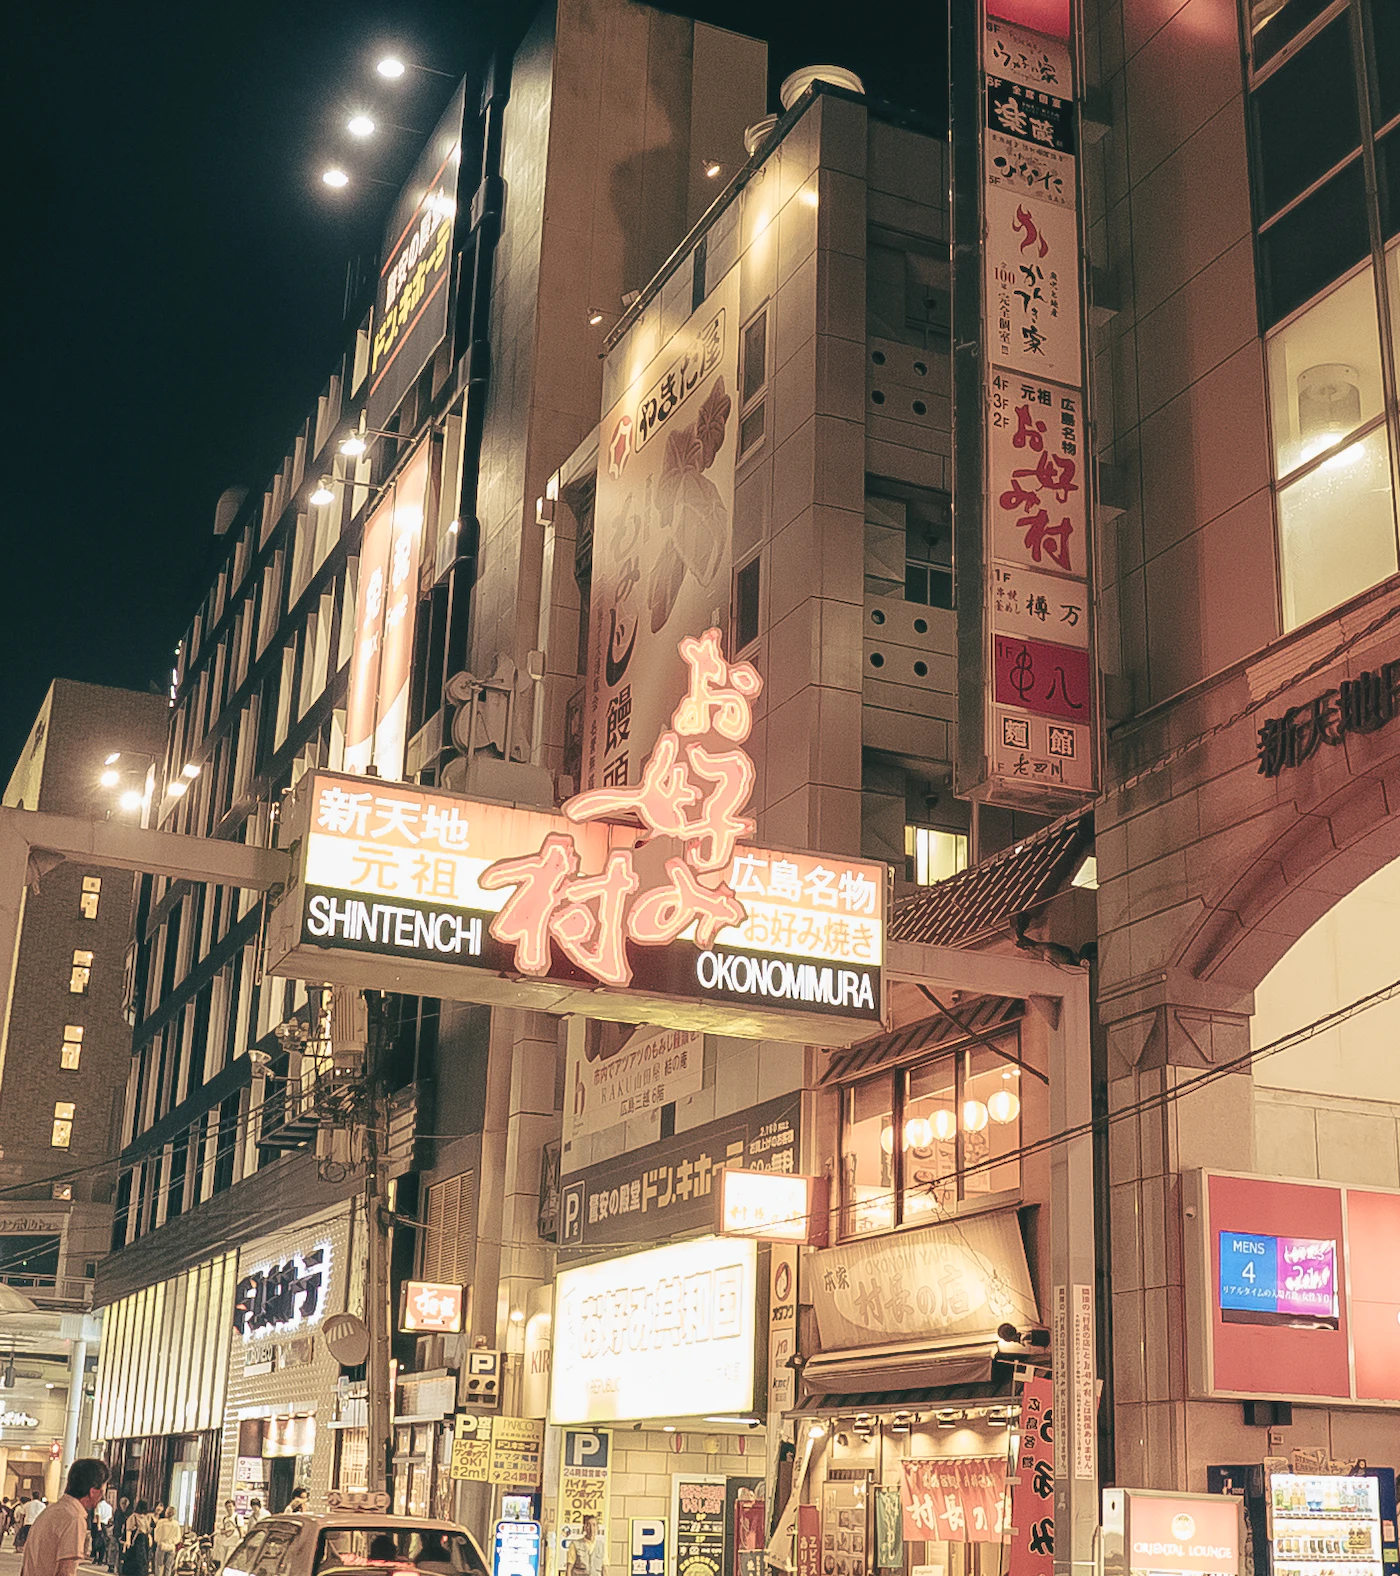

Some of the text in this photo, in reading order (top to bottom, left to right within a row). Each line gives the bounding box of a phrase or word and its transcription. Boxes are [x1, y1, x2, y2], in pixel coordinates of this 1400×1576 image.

[993, 156, 1063, 194] ひなた
[993, 375, 1009, 391] 4F
[1020, 383, 1052, 407] 元祖
[993, 393, 1009, 410] 3F
[993, 412, 1010, 429] 2F
[1061, 398, 1077, 456] 広島名物
[1000, 404, 1079, 571] お好み村
[994, 568, 1011, 583] 1F
[318, 786, 470, 851] 新天地
[479, 627, 765, 987] お好み村
[351, 845, 459, 900] 元祖
[730, 853, 877, 915] 広島名物
[307, 894, 482, 957] SHINTENCHI
[742, 906, 875, 959] お好み焼き
[696, 950, 875, 1011] OKONOMIMURA
[1233, 1240, 1265, 1256] MENS
[823, 1266, 850, 1292] 本家
[1241, 1261, 1256, 1284] 4
[853, 1264, 970, 1326] 村長の店
[472, 1354, 494, 1374] P
[455, 1415, 477, 1439] P
[503, 1418, 535, 1431] PARCO
[573, 1433, 601, 1466] P
[632, 1520, 665, 1556] P
[1188, 1542, 1233, 1560] LOUNGE
